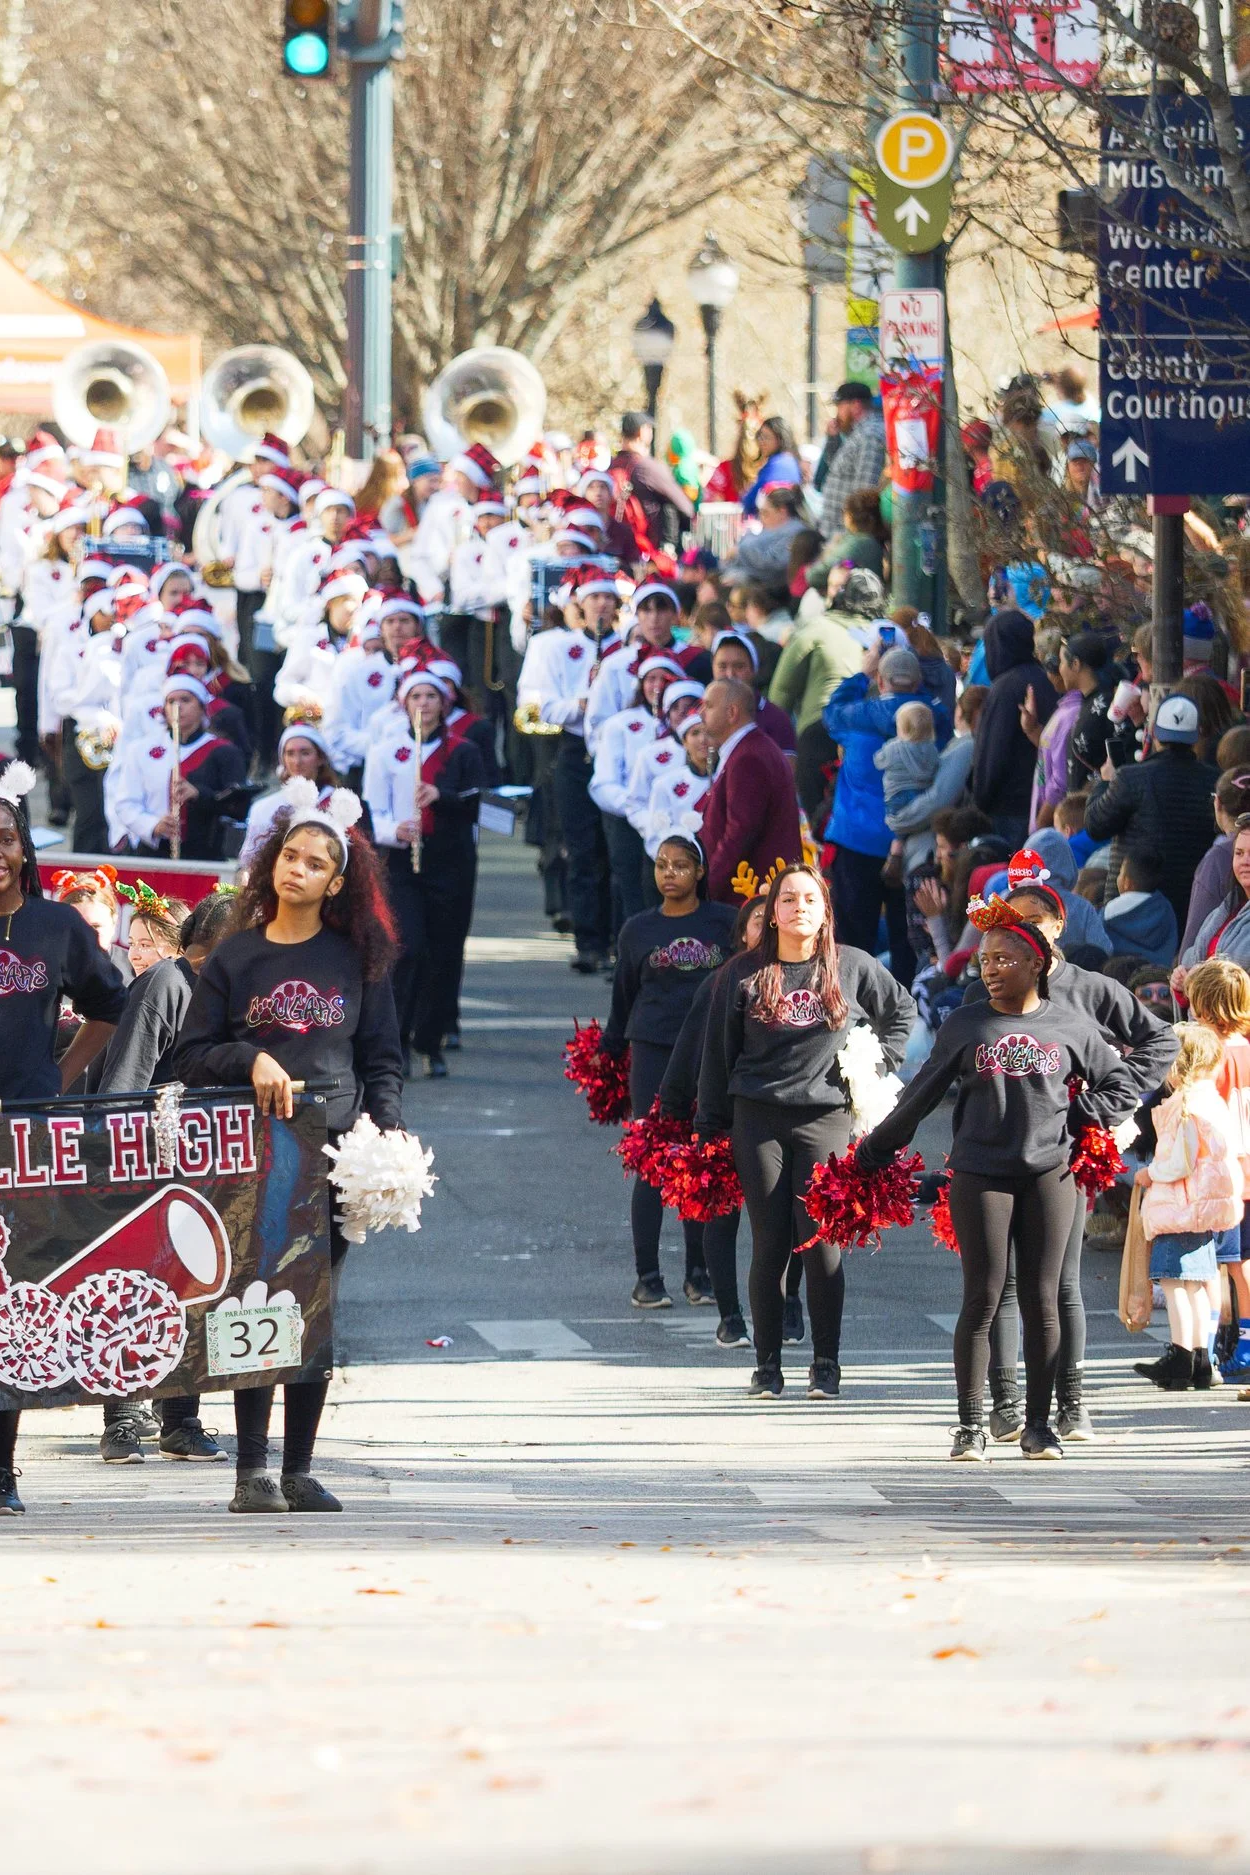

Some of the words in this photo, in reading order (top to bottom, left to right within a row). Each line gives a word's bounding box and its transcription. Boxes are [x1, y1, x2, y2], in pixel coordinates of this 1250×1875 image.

[899, 127, 934, 173] P
[1108, 160, 1228, 188] Musum
[1108, 260, 1205, 289] Center
[900, 300, 923, 316] NO
[1107, 351, 1209, 387] County
[1107, 389, 1250, 419] Courthou
[106, 1104, 257, 1183] HIGH
[225, 1309, 252, 1318] PARADE
[254, 1306, 282, 1315] NUMBER
[230, 1318, 279, 1359] 32
